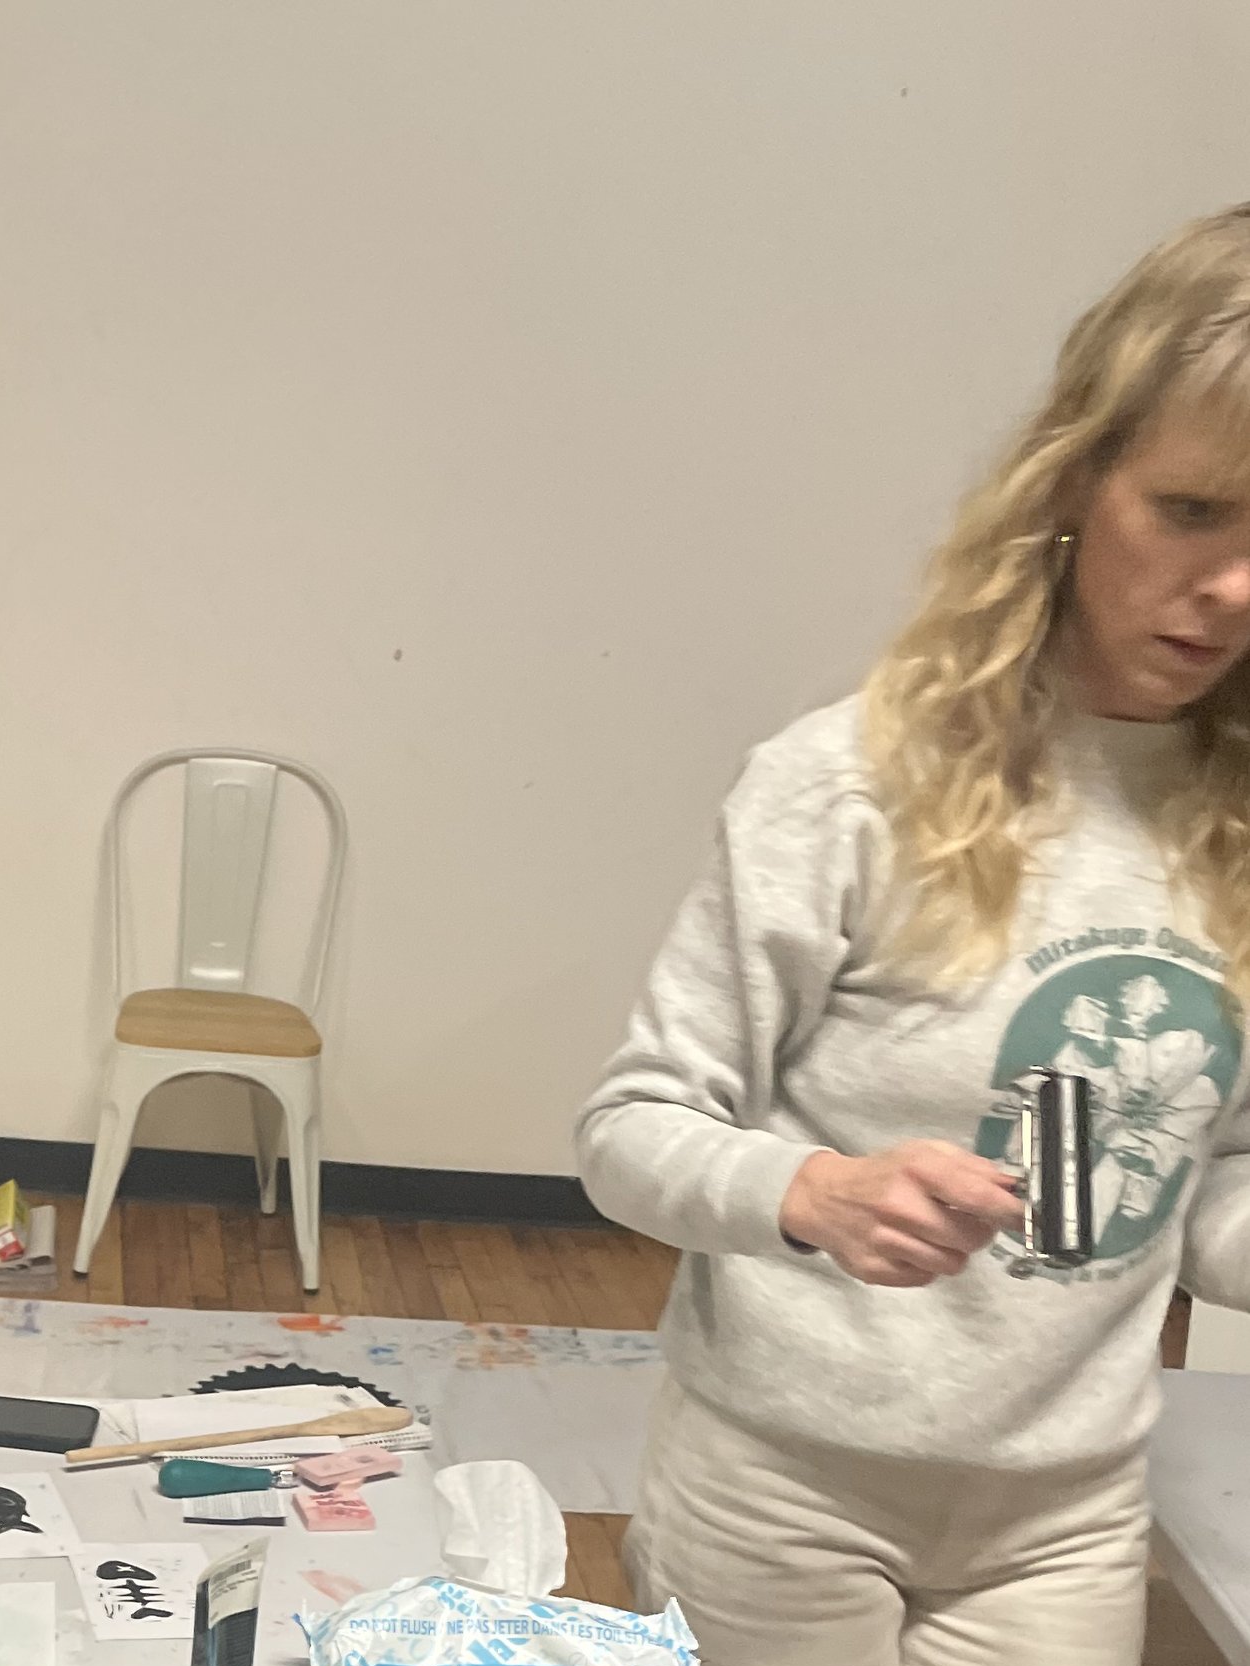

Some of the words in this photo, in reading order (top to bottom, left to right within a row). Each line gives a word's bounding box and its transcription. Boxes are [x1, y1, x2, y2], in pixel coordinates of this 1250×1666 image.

[401, 1620, 436, 1635] FLUSH
[447, 1620, 464, 1634] NE
[493, 1620, 529, 1634] JETER
